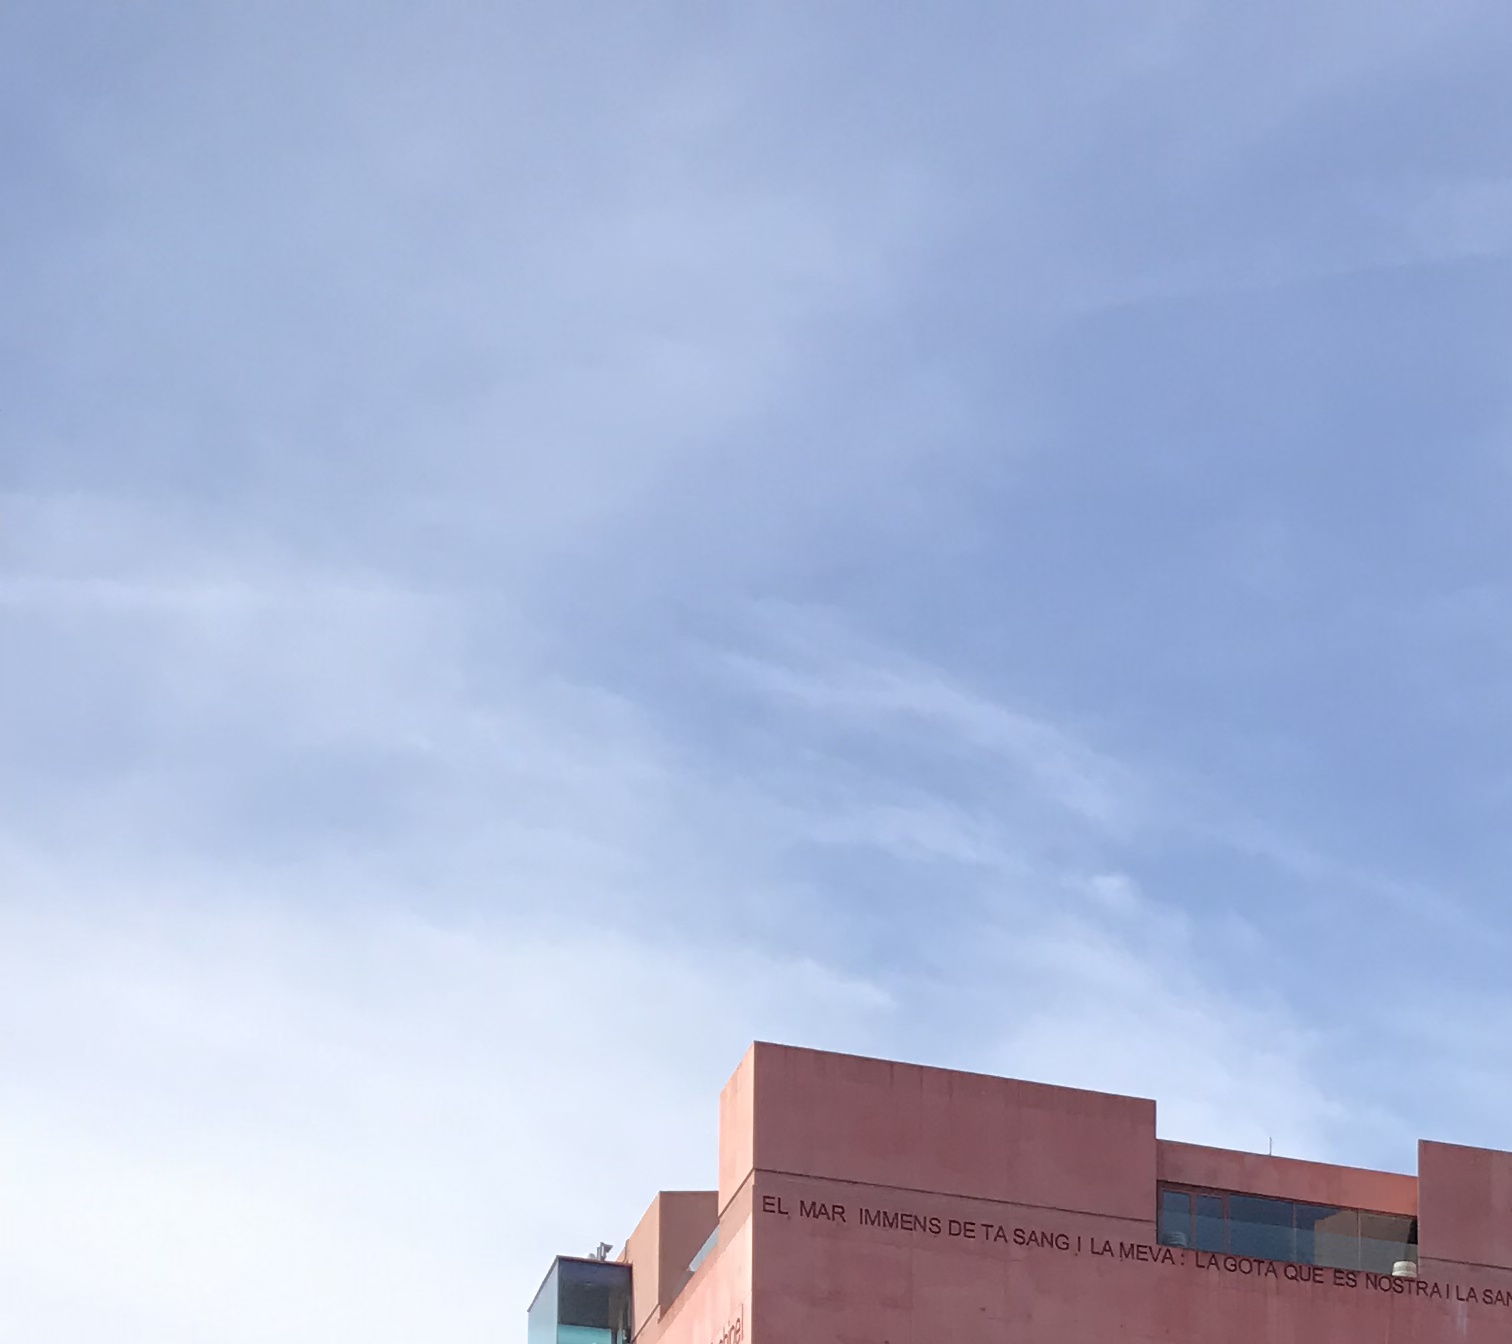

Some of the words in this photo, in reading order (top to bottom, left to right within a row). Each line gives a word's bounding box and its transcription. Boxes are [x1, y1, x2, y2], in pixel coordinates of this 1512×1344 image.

[762, 1196, 788, 1216] EL
[800, 1200, 846, 1222] MAR
[859, 1208, 942, 1235] IMMENS
[948, 1218, 976, 1239] DE
[980, 1223, 1008, 1243] TA
[1013, 1227, 1070, 1251] SANG
[1090, 1238, 1114, 1259] LA
[1195, 1251, 1220, 1270] LA
[1223, 1256, 1277, 1277] GOTA
[1285, 1264, 1324, 1286] QUE
[1366, 1273, 1444, 1300] NOSTRA
[1456, 1285, 1480, 1304] LA
